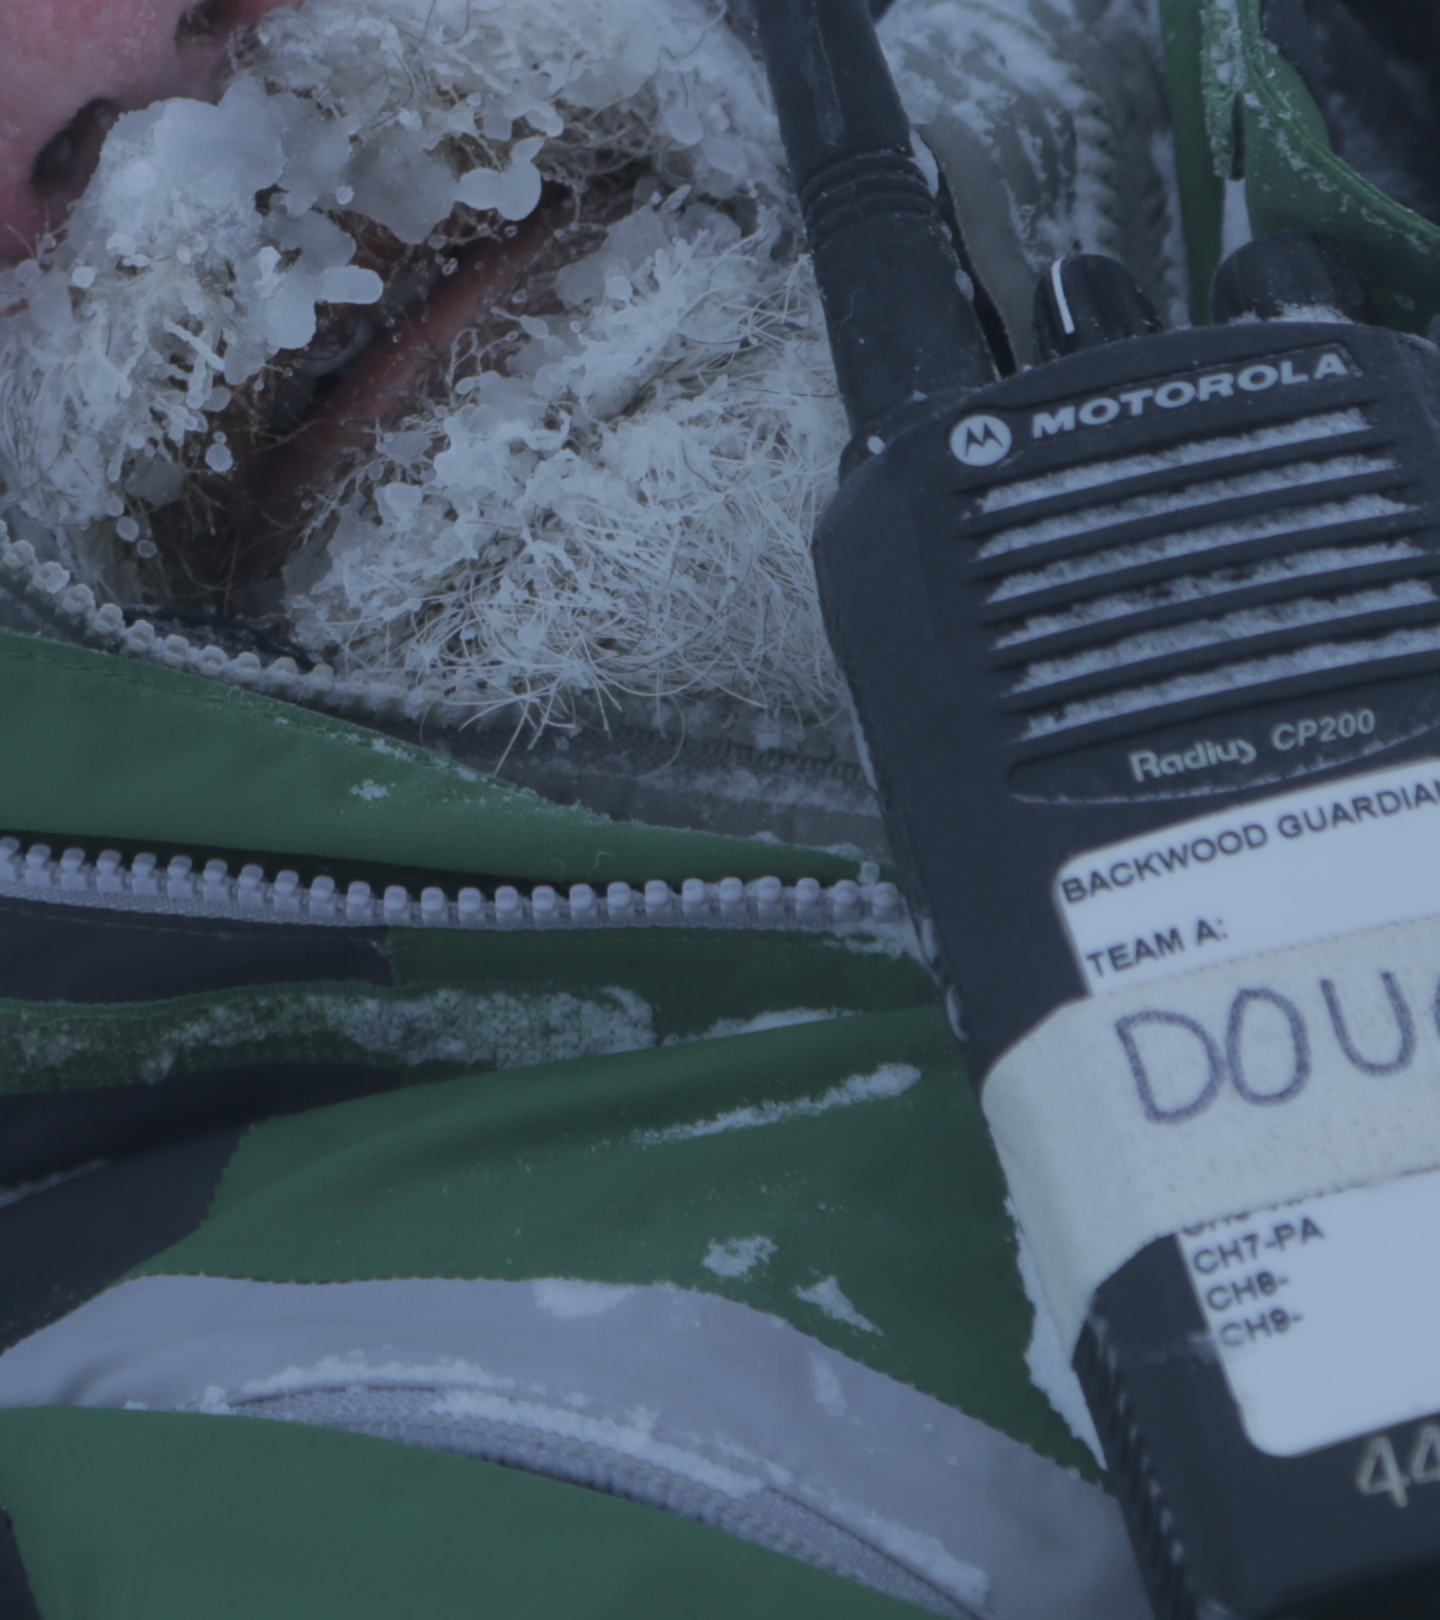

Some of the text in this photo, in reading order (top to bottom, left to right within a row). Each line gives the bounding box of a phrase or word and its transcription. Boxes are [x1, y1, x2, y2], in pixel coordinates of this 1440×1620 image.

[1031, 353, 1347, 438] MOTOROLA
[1129, 708, 1376, 783] Radius CP200
[1060, 823, 1269, 904] BACKWOOD
[1086, 917, 1229, 978] TEAM A:
[1194, 1217, 1326, 1274] CH7-PA
[1207, 1271, 1289, 1311] CH8-
[1221, 1308, 1302, 1347] CH9-
